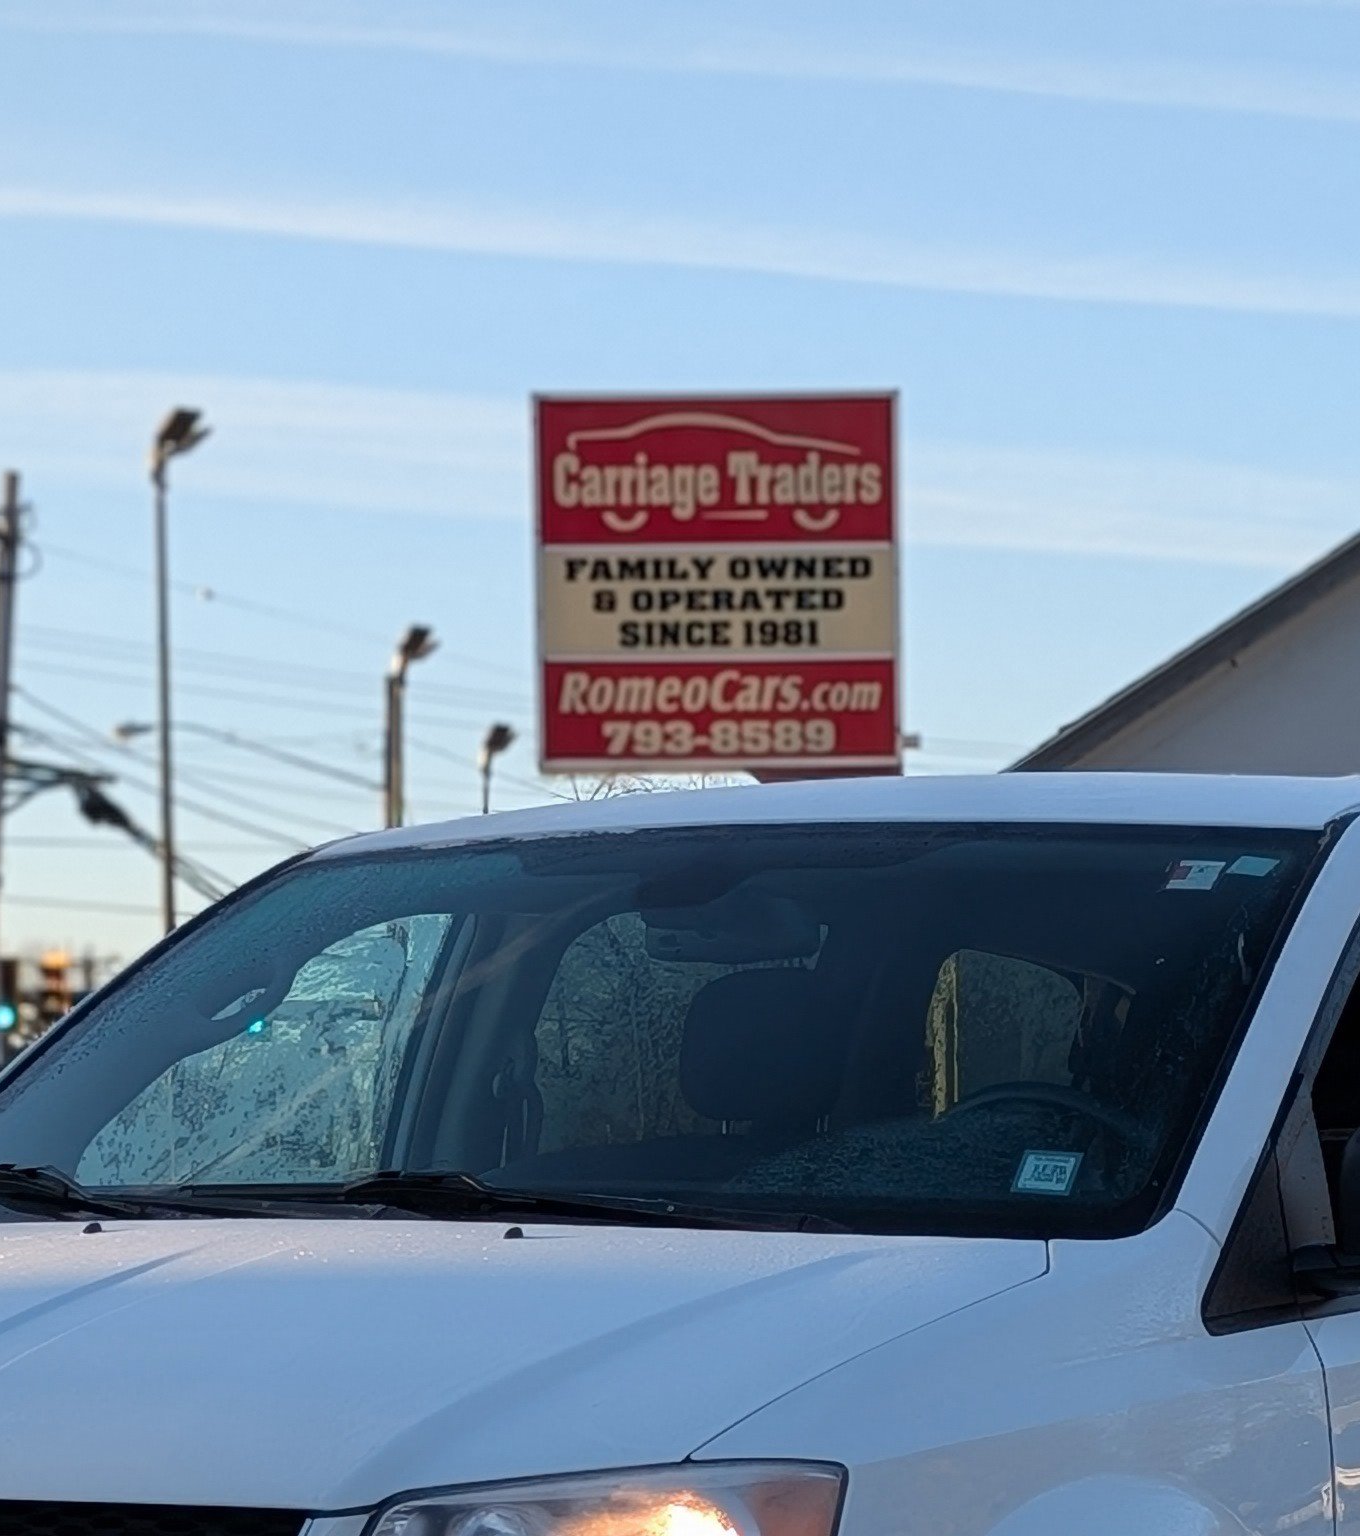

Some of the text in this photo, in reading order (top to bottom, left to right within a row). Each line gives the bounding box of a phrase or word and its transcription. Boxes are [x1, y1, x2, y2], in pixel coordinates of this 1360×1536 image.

[553, 451, 882, 521] Carriage Traders
[565, 557, 872, 581] FAMILY OWNED
[631, 589, 844, 611] OPERATED
[619, 621, 819, 647] SINCE 1981
[559, 670, 882, 714] RomeoCars.com
[602, 720, 835, 755] 793-8589
